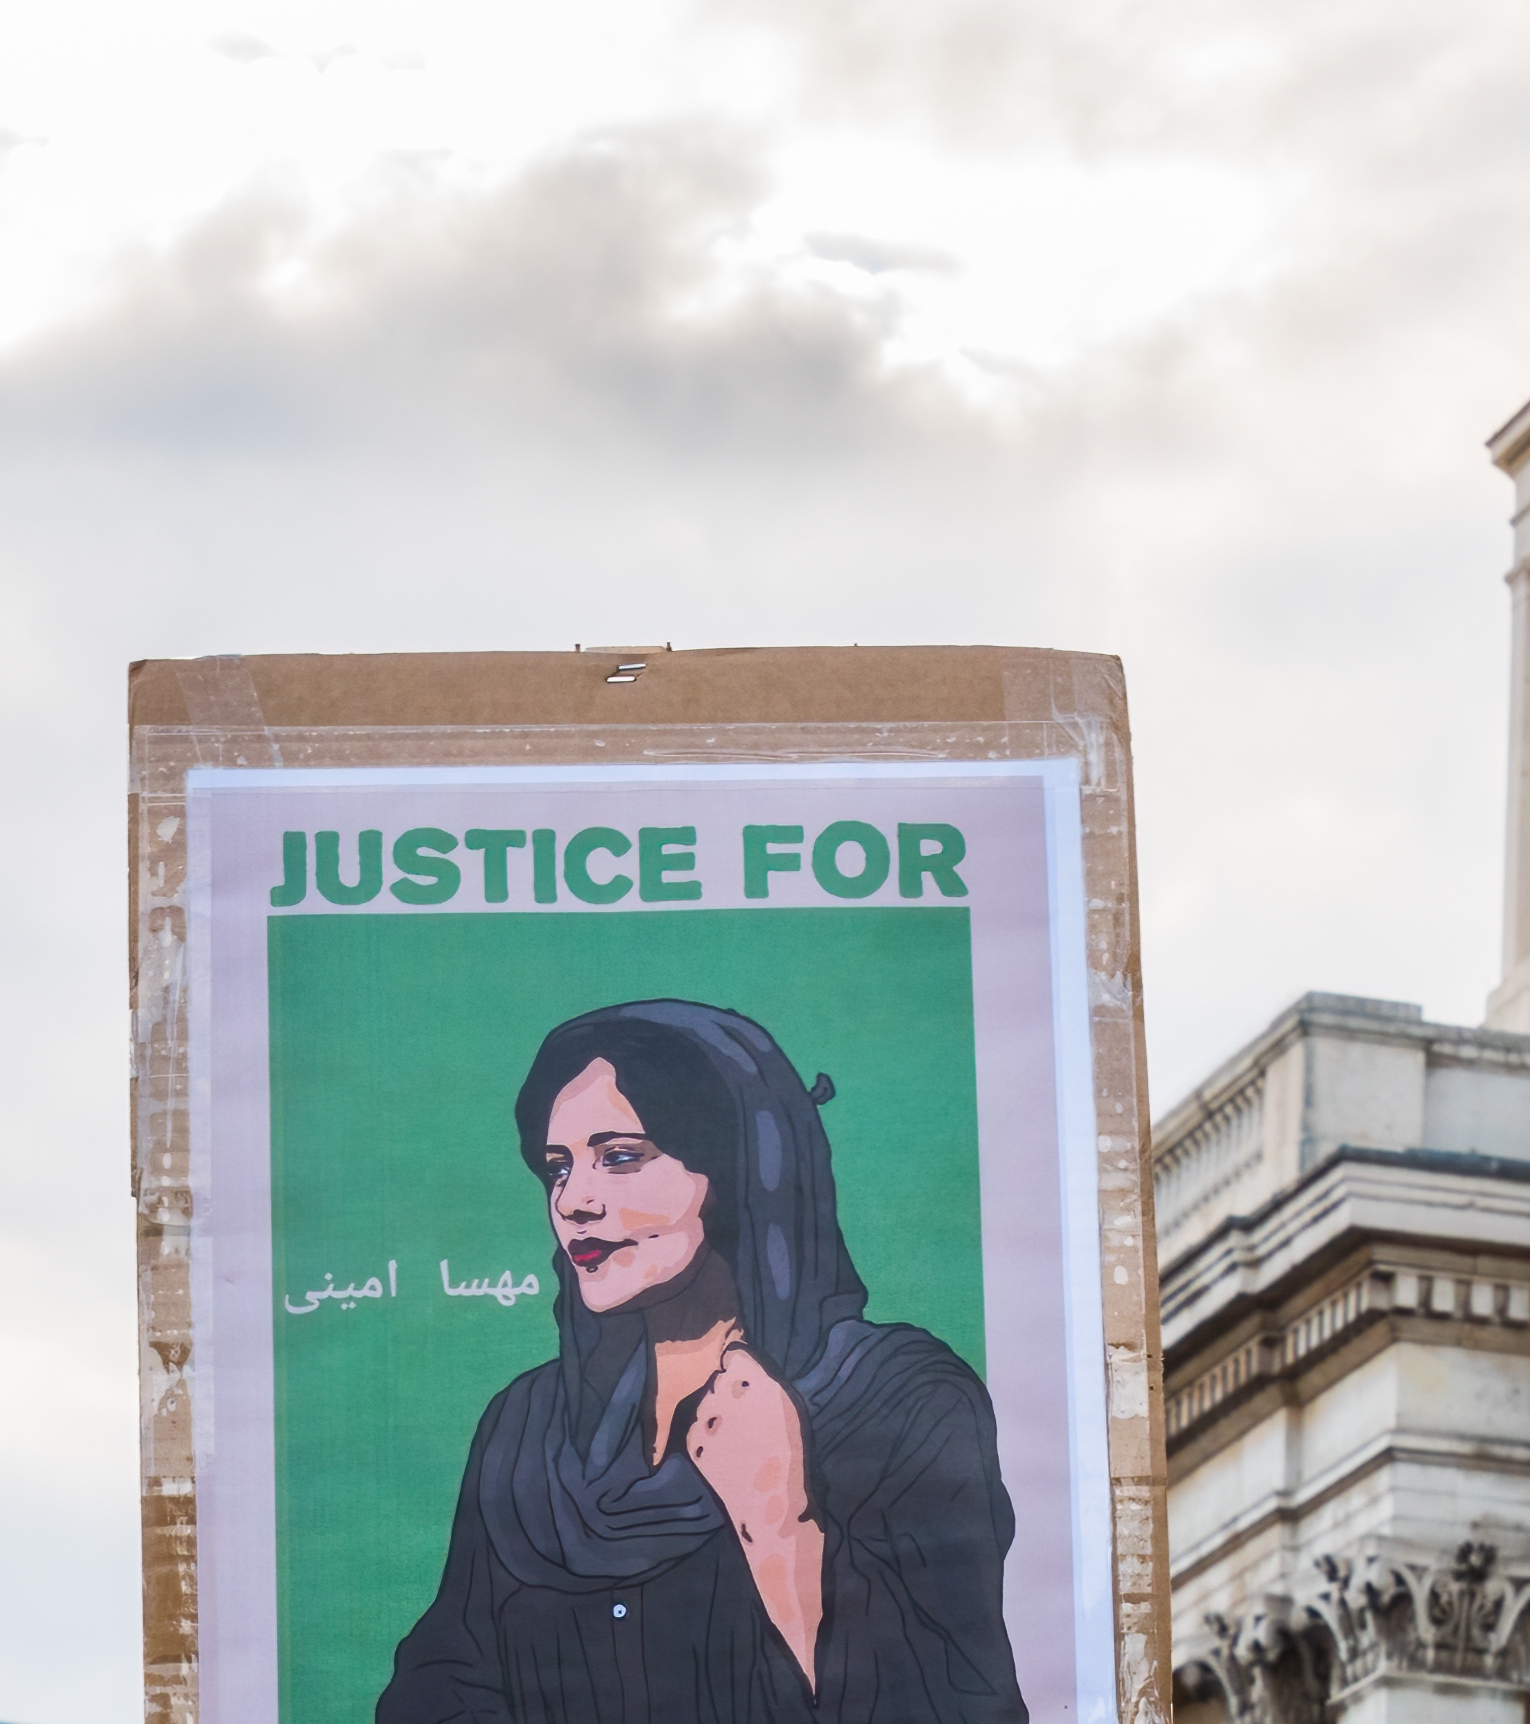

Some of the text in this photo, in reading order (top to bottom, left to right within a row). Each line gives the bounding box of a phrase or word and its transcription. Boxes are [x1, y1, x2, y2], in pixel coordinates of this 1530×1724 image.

[269, 819, 970, 908] JUSTICE FOR
[439, 1258, 540, 1307] مهسا
